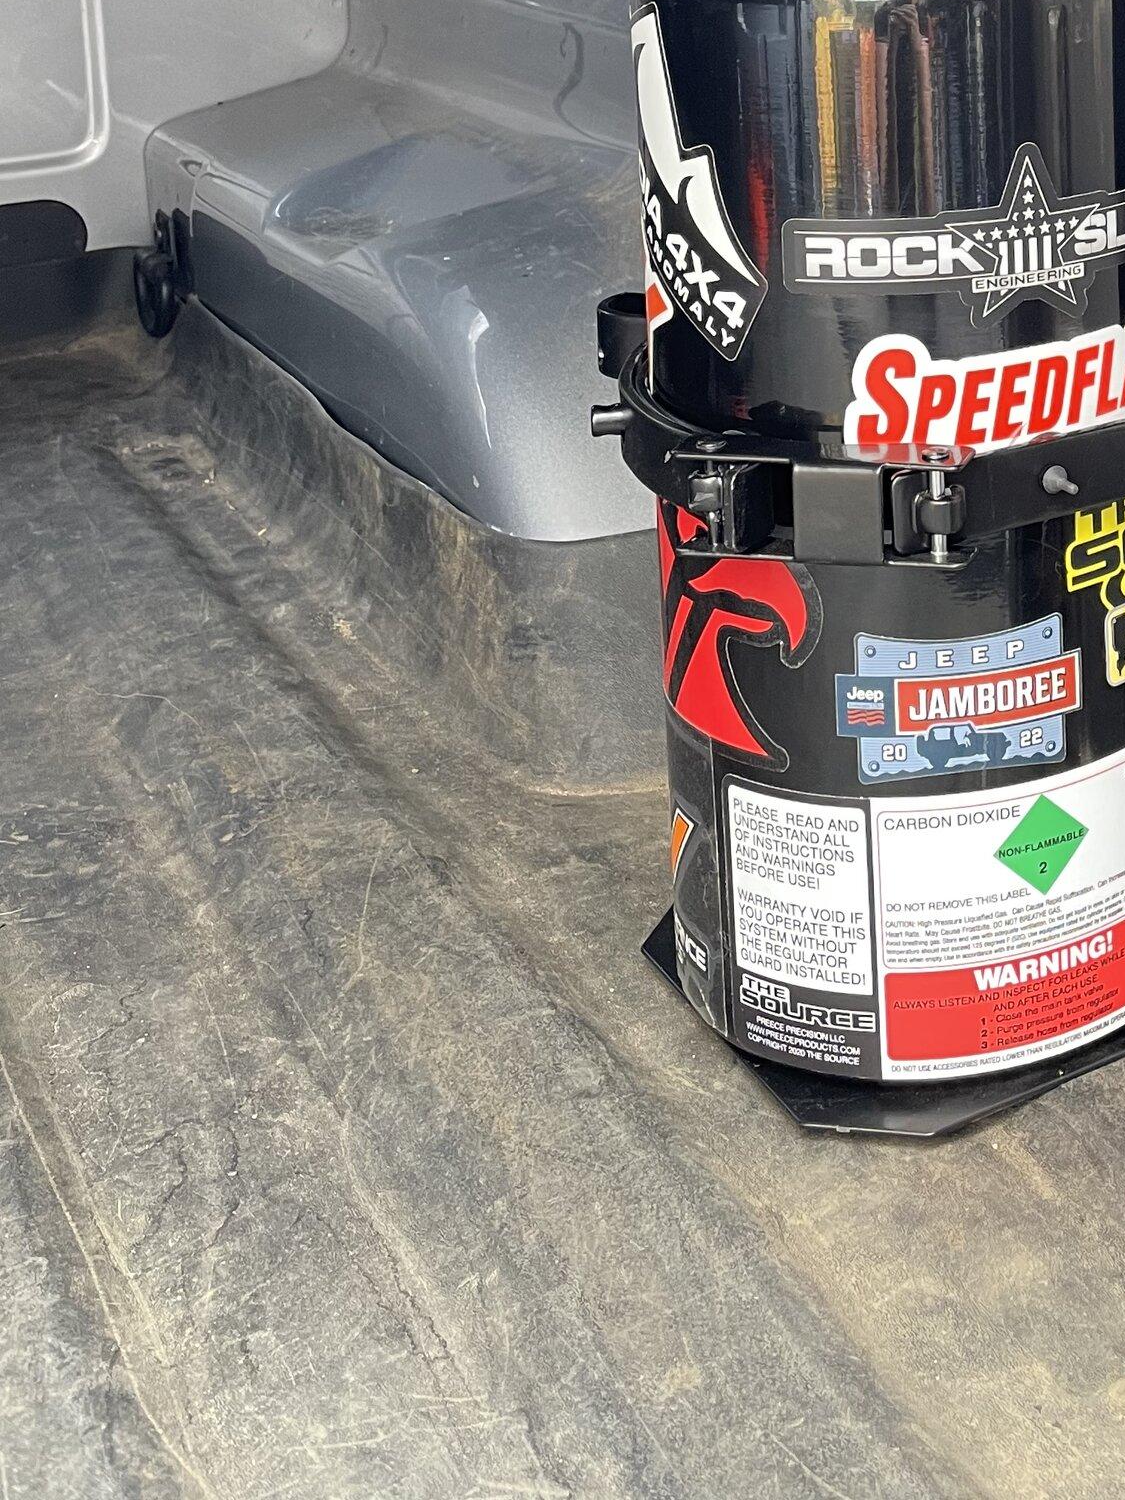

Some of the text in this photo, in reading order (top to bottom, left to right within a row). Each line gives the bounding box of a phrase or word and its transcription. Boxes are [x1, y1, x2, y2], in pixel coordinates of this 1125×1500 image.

[805, 234, 985, 278] ROCK
[666, 233, 746, 329] 4X4
[975, 265, 1082, 290] ENGINEERING
[898, 640, 1024, 670] JEEP
[846, 666, 1067, 721] Jeep JAMBOREE
[882, 727, 1043, 761] 20 22
[734, 798, 859, 833] PLEASE READ AND
[734, 813, 849, 847] UNDERSTAND ALL
[884, 805, 1021, 831] CARBON DIOXIDE
[735, 829, 854, 863] OF INSTRUCTIONS
[736, 844, 835, 876] AND WARNINGS
[998, 828, 1085, 859] NON-FLAMMABLE
[737, 858, 820, 890] BEFORE USE!
[1039, 861, 1048, 874] 2
[738, 887, 863, 923] WARRANTY VOID IF
[886, 887, 1031, 912] DO NOT REMOVE THIS LABEL
[934, 918, 962, 926] Pressure
[1012, 907, 1024, 915] Can
[739, 903, 866, 940] YOU OPERATE THIS
[740, 918, 856, 954] SYSTEM WITHOUT
[925, 930, 938, 938] May
[741, 933, 847, 968] THE REGULATOR
[741, 948, 866, 985] GUARD INSTALLED!
[973, 931, 1114, 992] WARNING!
[742, 975, 789, 999] THE
[893, 1000, 935, 1010] ALWAYS
[938, 996, 976, 1008] LISTEN
[978, 992, 1000, 1003] AND
[1002, 981, 1045, 999] INSPECT
[1049, 974, 1068, 987] FOR
[1070, 962, 1099, 979] LEAKS
[1100, 948, 1125, 966] WHILE
[993, 974, 1099, 1012] AND AFTER EACH USE
[741, 988, 875, 1031] SOURCE
[996, 1011, 1022, 1023] Close
[1025, 1006, 1039, 1016] the
[1042, 1000, 1062, 1012] main
[1065, 993, 1081, 1005] tank
[1084, 984, 1104, 997] valve
[997, 1022, 1023, 1034] Purge
[1026, 1011, 1063, 1030] pressure
[1067, 1004, 1084, 1015] from
[1086, 988, 1119, 1008] regulator
[746, 1021, 861, 1055] WWW.PREECEPRODUCTS.COM
[756, 1016, 845, 1043] PREECE PRECISION LLC
[997, 1032, 1034, 1047] Release
[1037, 1026, 1058, 1037] hose
[1060, 1018, 1079, 1029] from
[1080, 1002, 1114, 1024] regulator
[748, 1032, 859, 1065] COPYRIGHT 2020 THE SOURCE
[933, 1060, 978, 1070] ACCESSORIES
[980, 1057, 1000, 1065] RATED
[1002, 1050, 1026, 1062] LOWER
[1026, 1045, 1042, 1056] THAN
